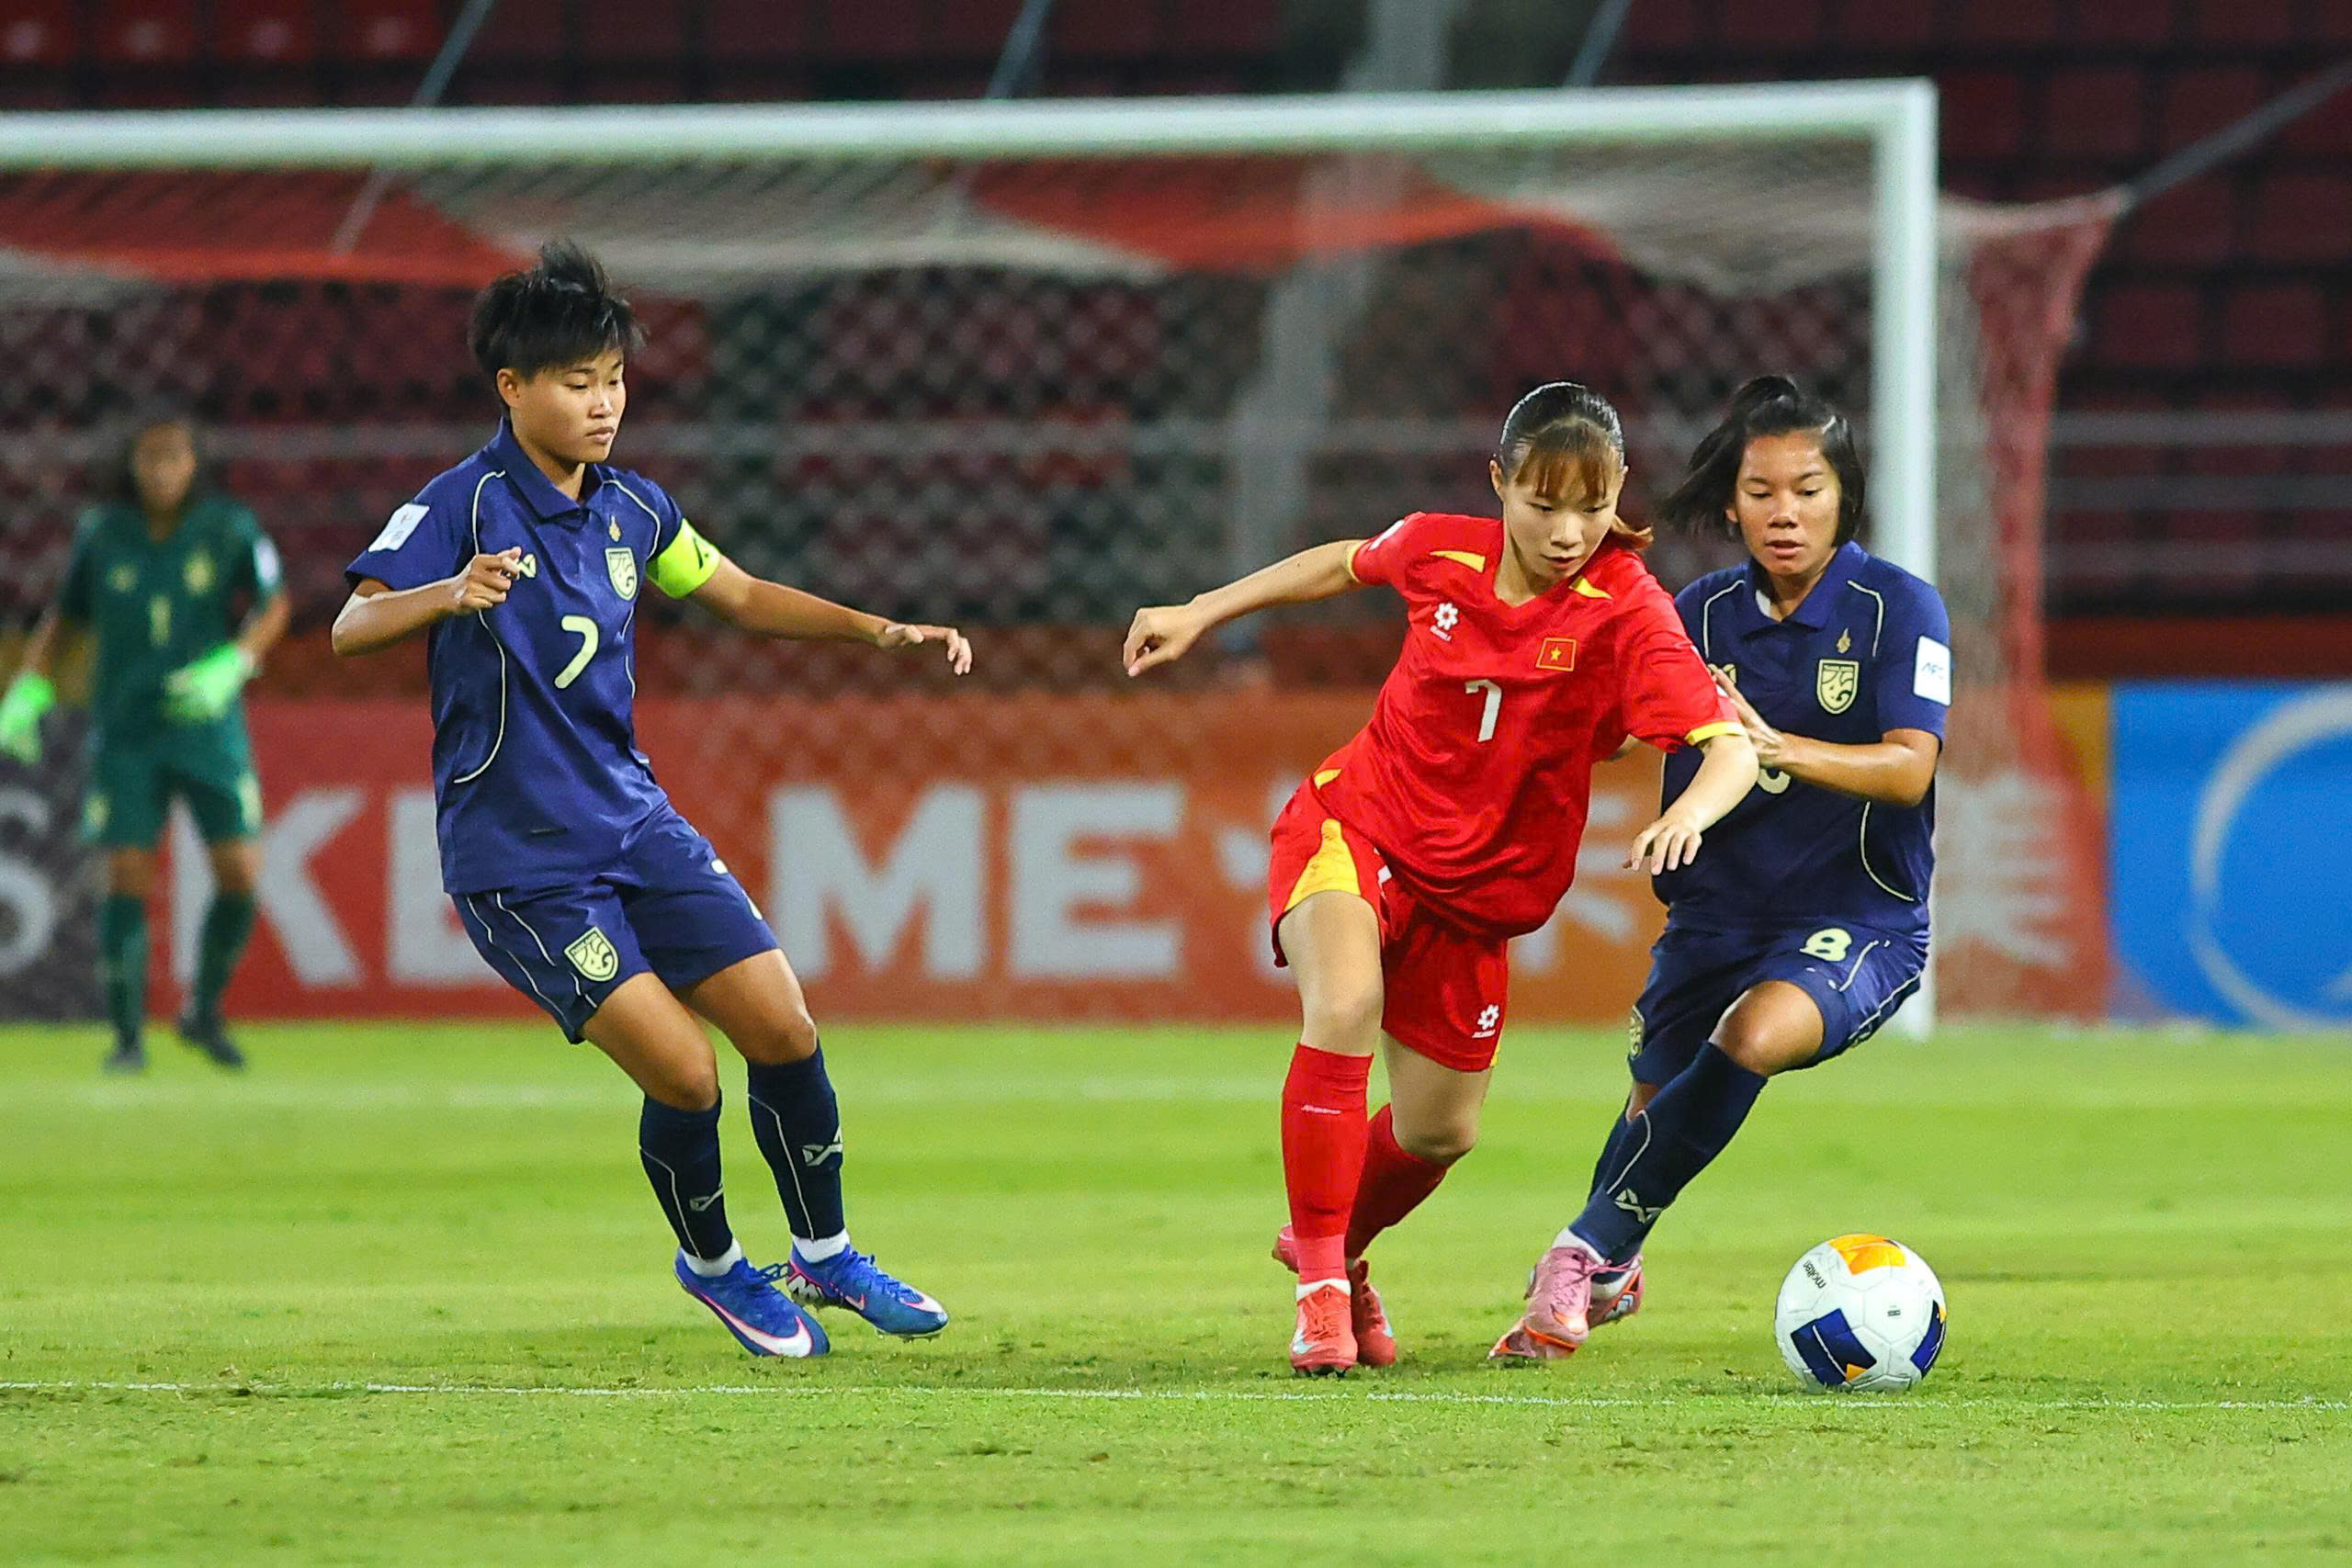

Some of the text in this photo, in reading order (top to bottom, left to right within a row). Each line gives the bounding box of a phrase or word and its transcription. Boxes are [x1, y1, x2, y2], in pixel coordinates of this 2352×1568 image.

[554, 615, 599, 688] 7
[1464, 679, 1502, 742] 7
[1799, 927, 1853, 962] 8
